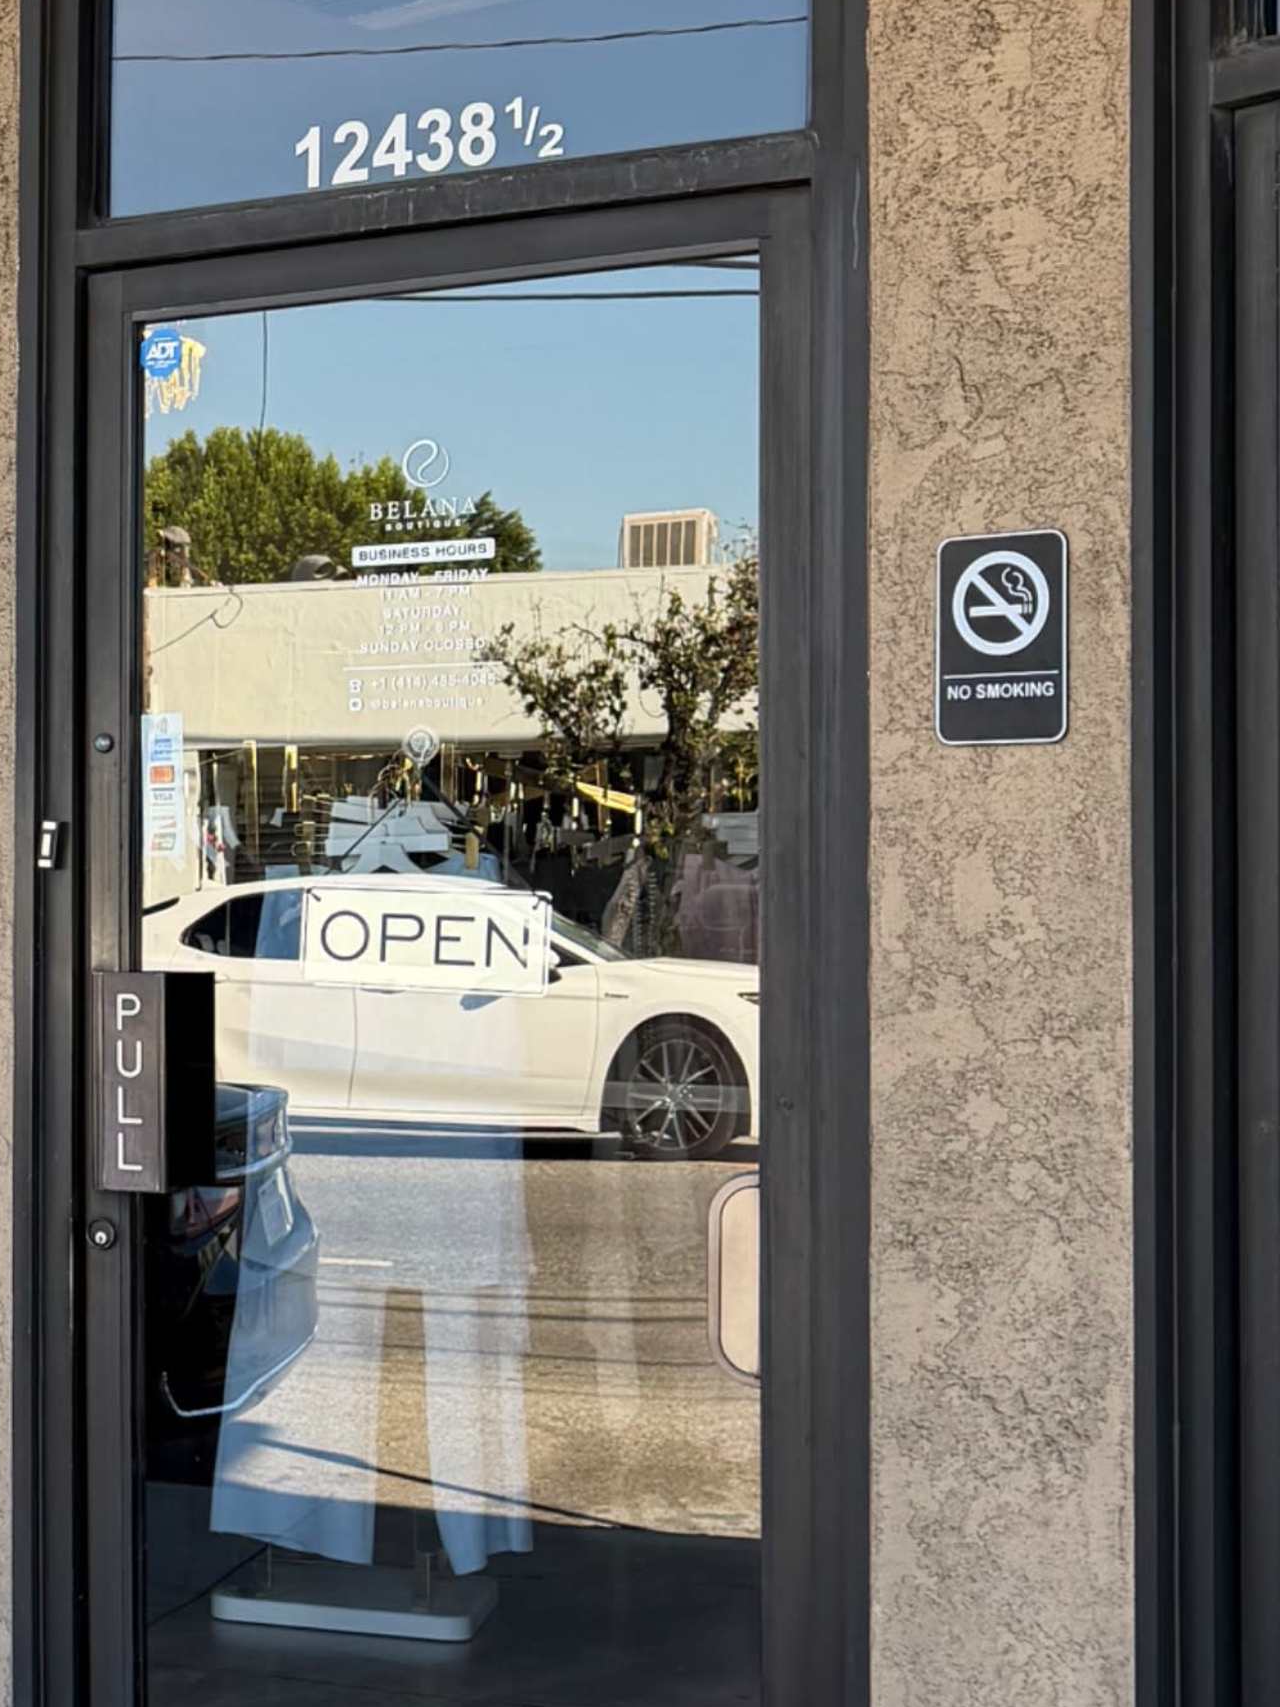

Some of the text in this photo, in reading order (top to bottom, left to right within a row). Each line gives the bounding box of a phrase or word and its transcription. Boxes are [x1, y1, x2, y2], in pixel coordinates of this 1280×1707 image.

[145, 341, 179, 361] ADT
[369, 497, 477, 522] BELANA
[385, 520, 462, 532] BOUTIQUE
[358, 543, 488, 562] BUSINESS HOURS
[356, 572, 420, 587] MONDAY
[434, 568, 489, 583] FRIDAY
[383, 605, 461, 619] SATURDAY
[359, 637, 486, 655] SUNDAY CLOSED
[946, 681, 1055, 701] NO SMOKING
[320, 910, 530, 969] OPEN
[116, 992, 143, 1171] PULL
